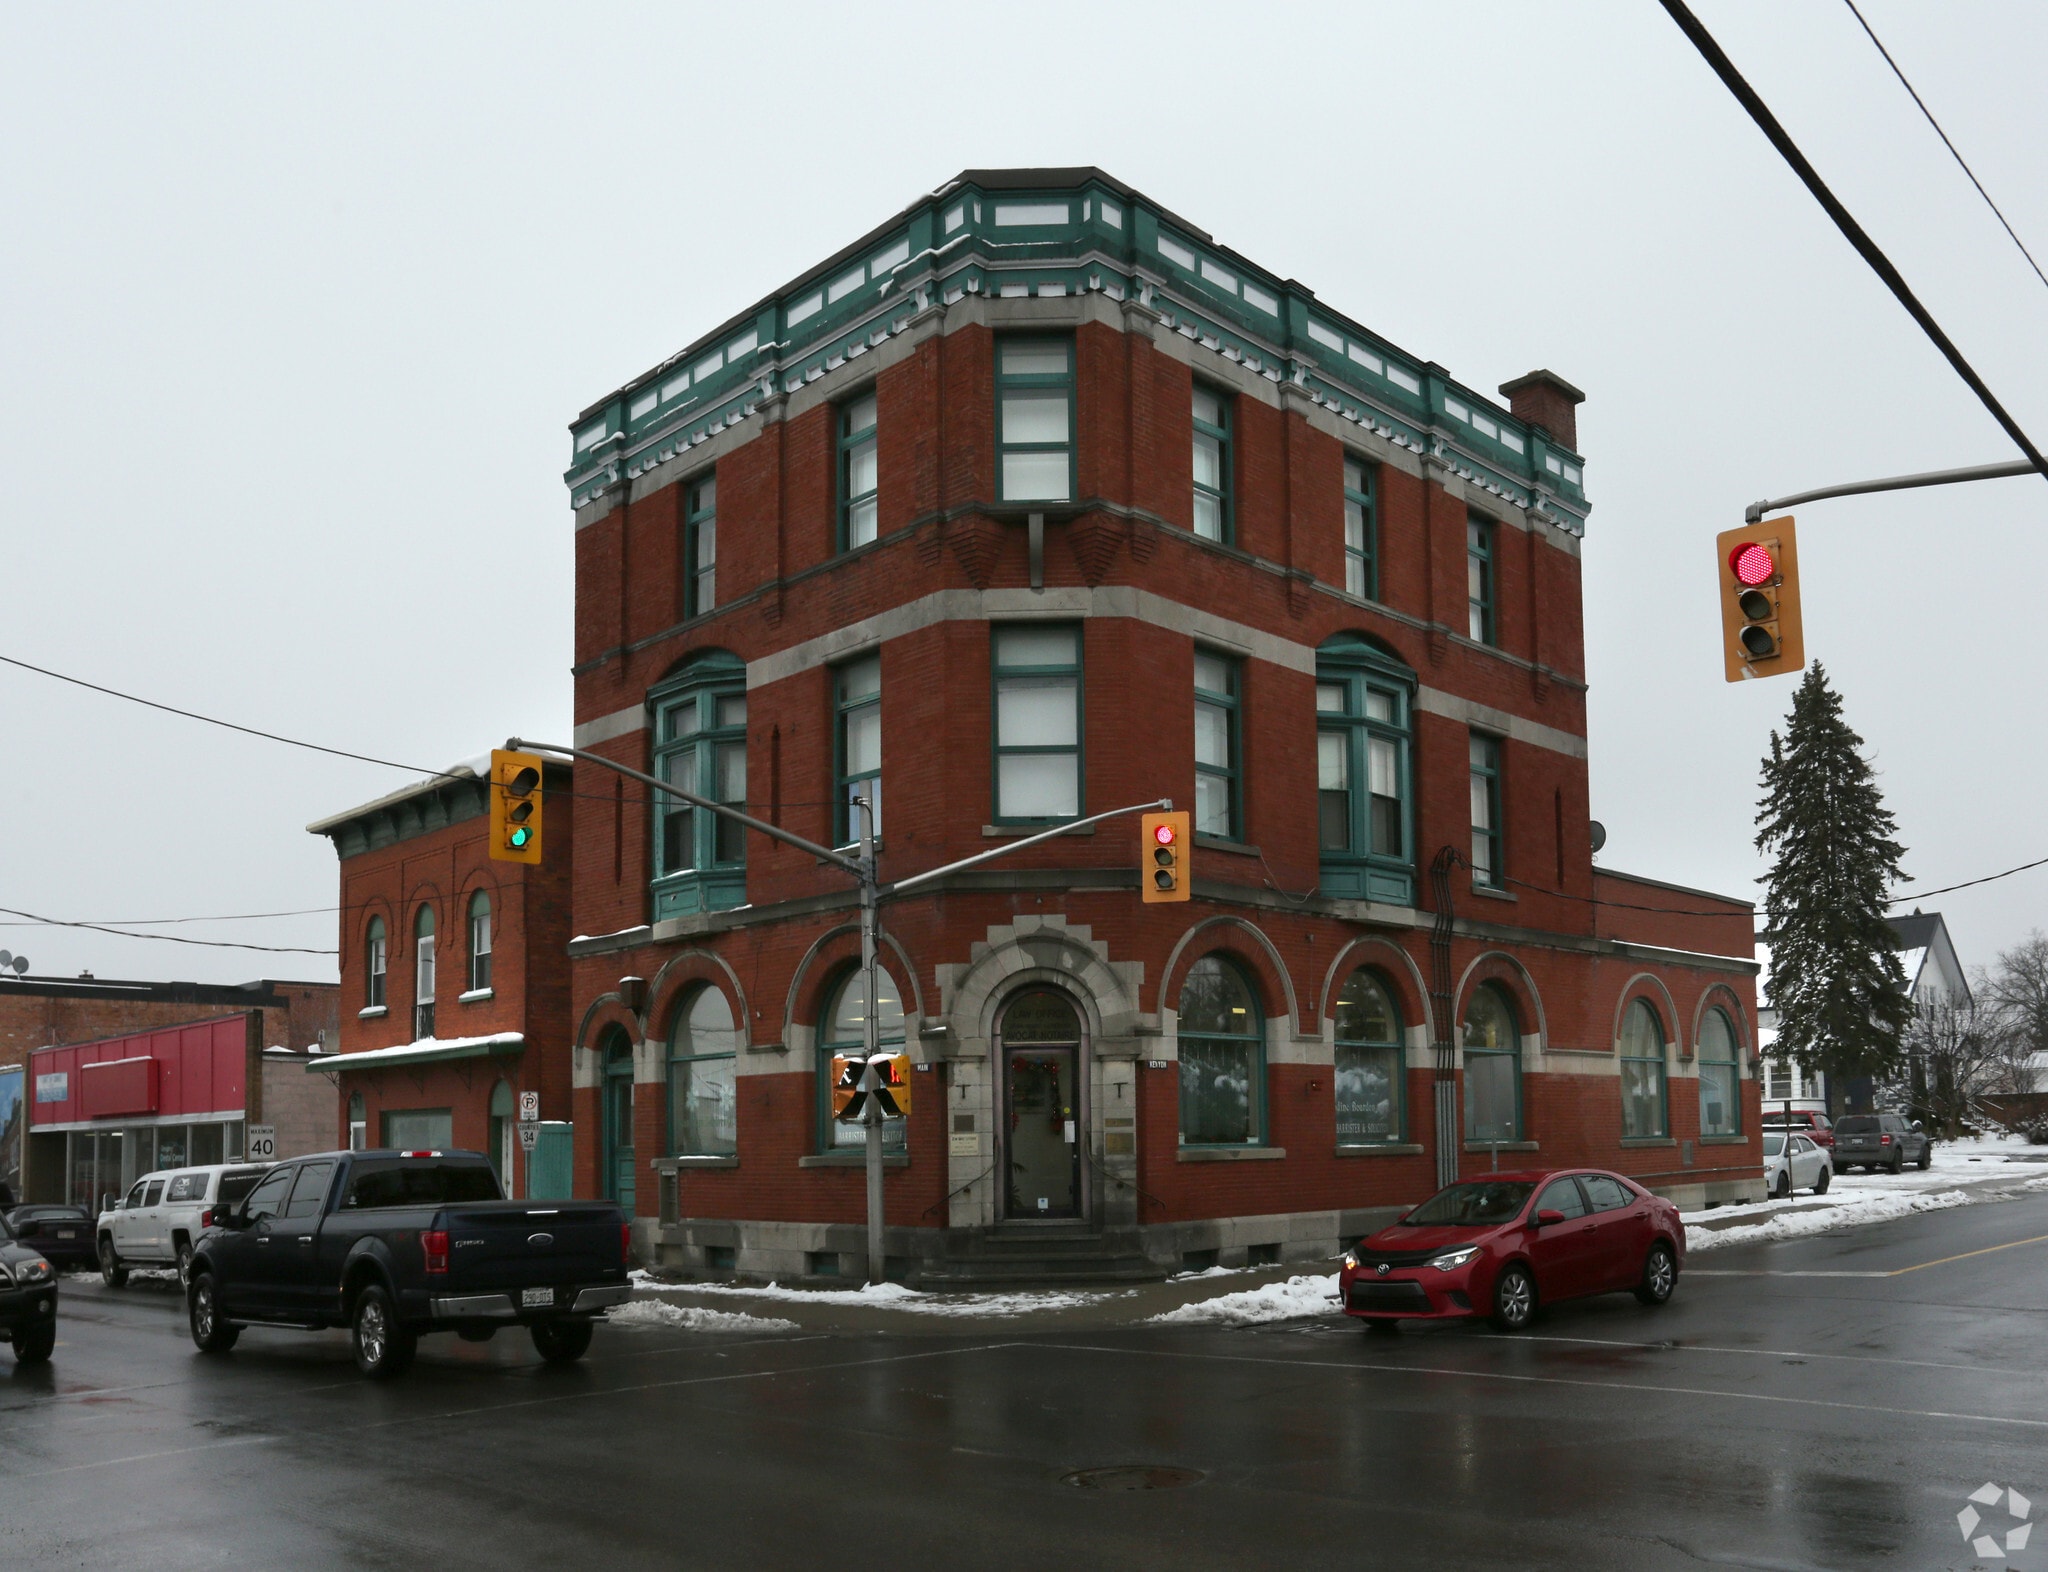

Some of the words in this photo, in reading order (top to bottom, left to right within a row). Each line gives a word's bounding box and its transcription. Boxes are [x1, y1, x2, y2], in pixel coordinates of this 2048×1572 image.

[917, 1063, 929, 1072] MAIN
[524, 1131, 534, 1142] 34
[251, 1139, 274, 1155] 40
